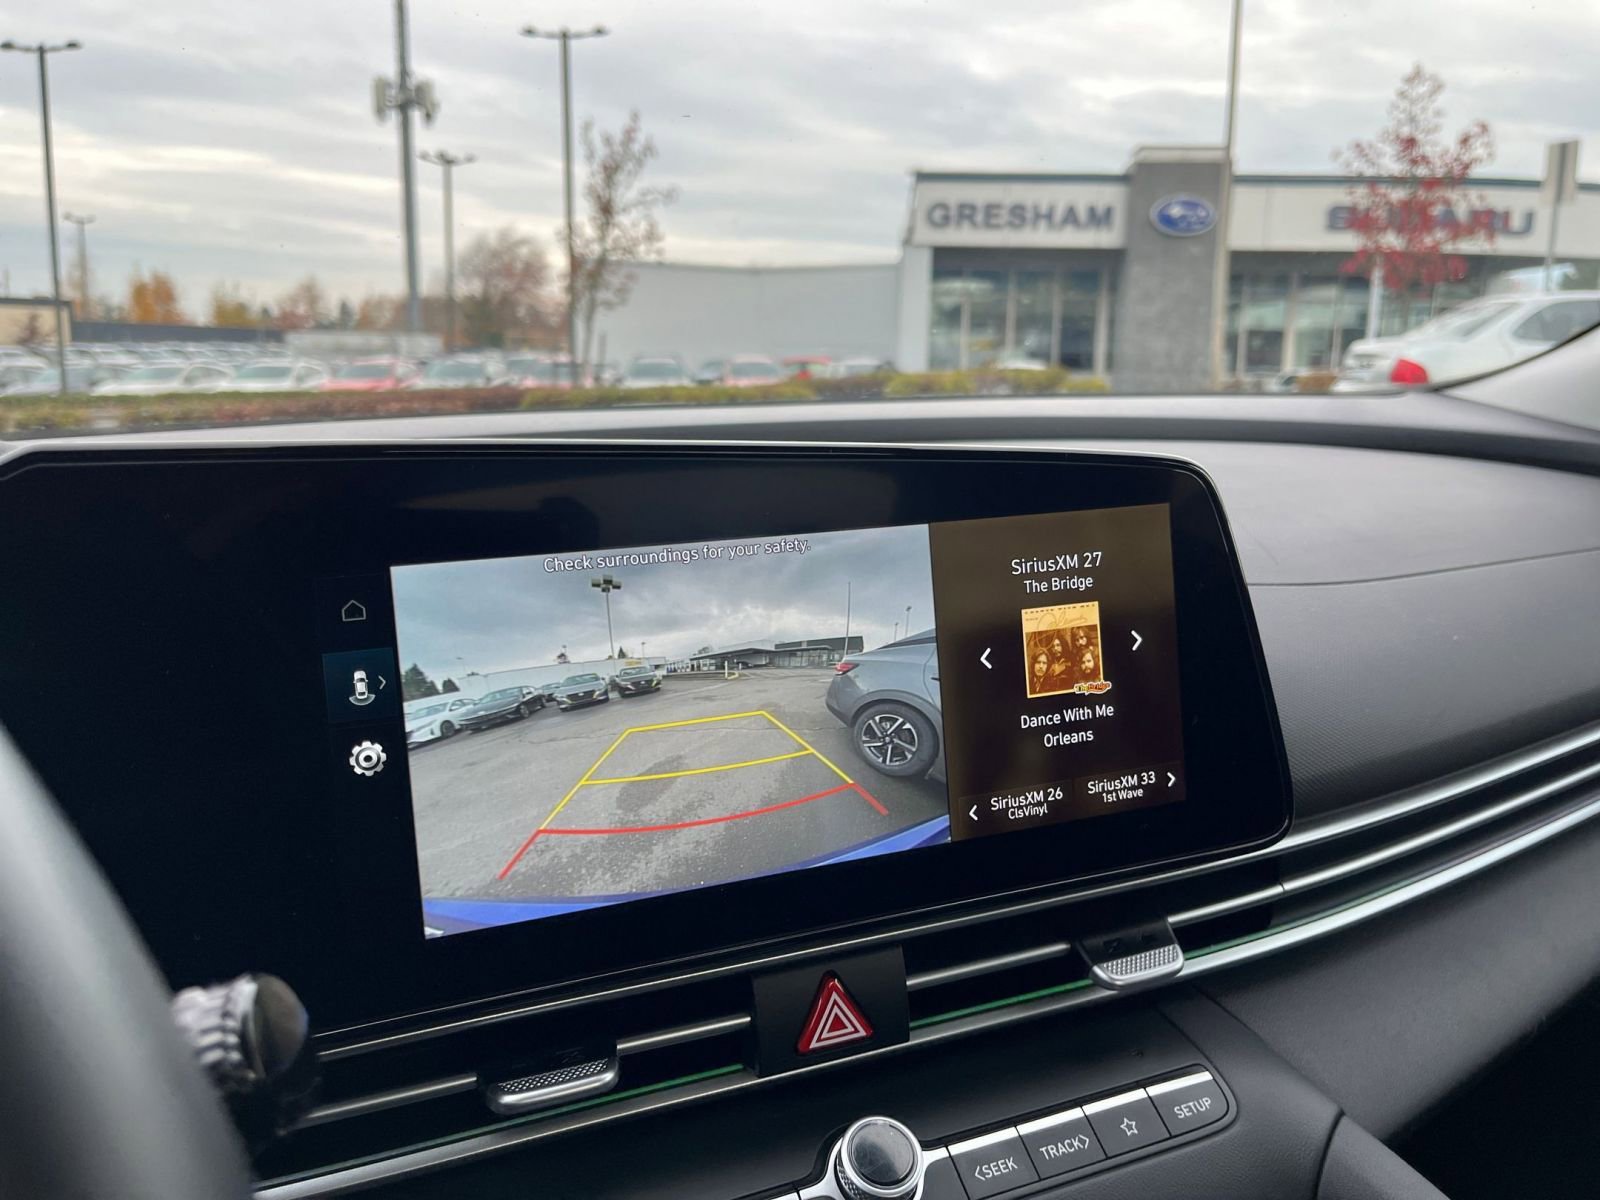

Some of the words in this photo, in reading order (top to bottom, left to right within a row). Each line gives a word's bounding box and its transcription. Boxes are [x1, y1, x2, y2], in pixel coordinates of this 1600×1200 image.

[927, 202, 1114, 231] GRESHAM
[543, 554, 593, 573] Check
[595, 548, 700, 569] surroundings
[701, 545, 726, 559] for
[728, 541, 761, 560] your
[763, 537, 812, 555] safety.
[1011, 554, 1079, 575] SiriusXM
[1083, 551, 1103, 568] 27
[1023, 578, 1049, 594] The
[1051, 575, 1094, 593] Bridge
[1020, 712, 1062, 729] Dance
[1063, 707, 1093, 724] With
[1095, 704, 1115, 719] Me
[1043, 729, 1094, 748] Orleans
[1087, 774, 1139, 795] SiriusXM
[1141, 771, 1156, 786] 33
[990, 790, 1045, 811] SiriusXM
[1047, 787, 1064, 802] 26
[1102, 791, 1117, 804] 1st
[1117, 787, 1144, 800] Wave
[1007, 804, 1049, 820] ClsVinyl
[1173, 1097, 1212, 1120] SETUP
[1039, 1137, 1083, 1160] TRACK
[983, 1156, 1018, 1179] SEEK
